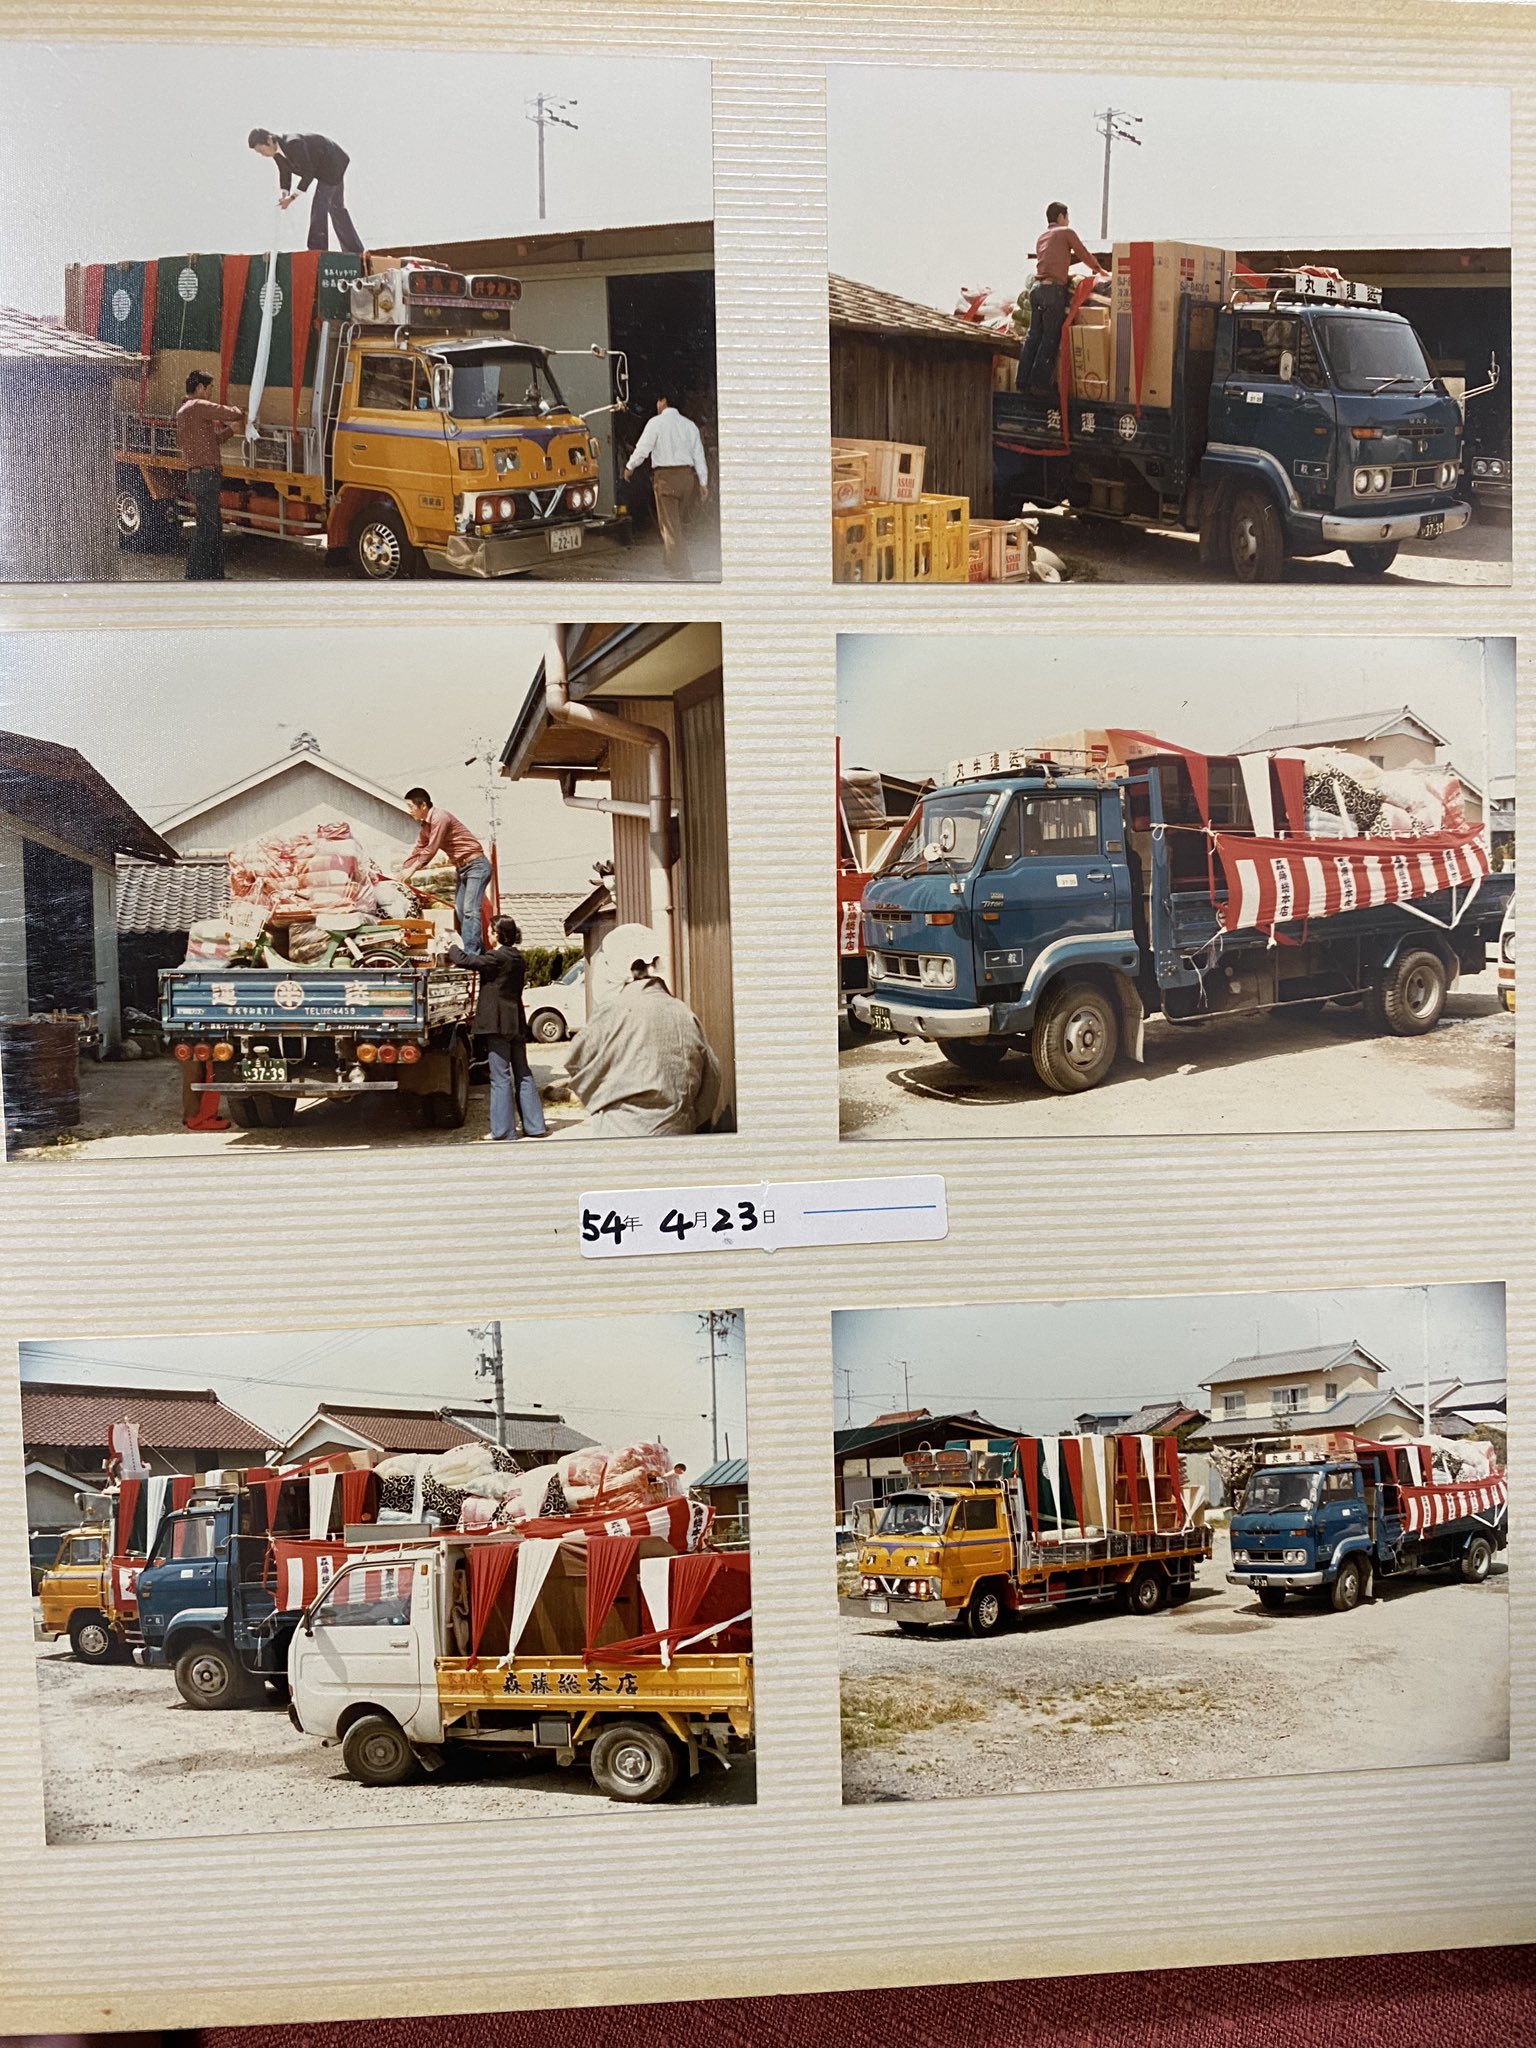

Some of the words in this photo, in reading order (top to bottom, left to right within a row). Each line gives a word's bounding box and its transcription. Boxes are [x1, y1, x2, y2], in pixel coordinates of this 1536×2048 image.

[502, 1672, 639, 1695] 森藤総本店
